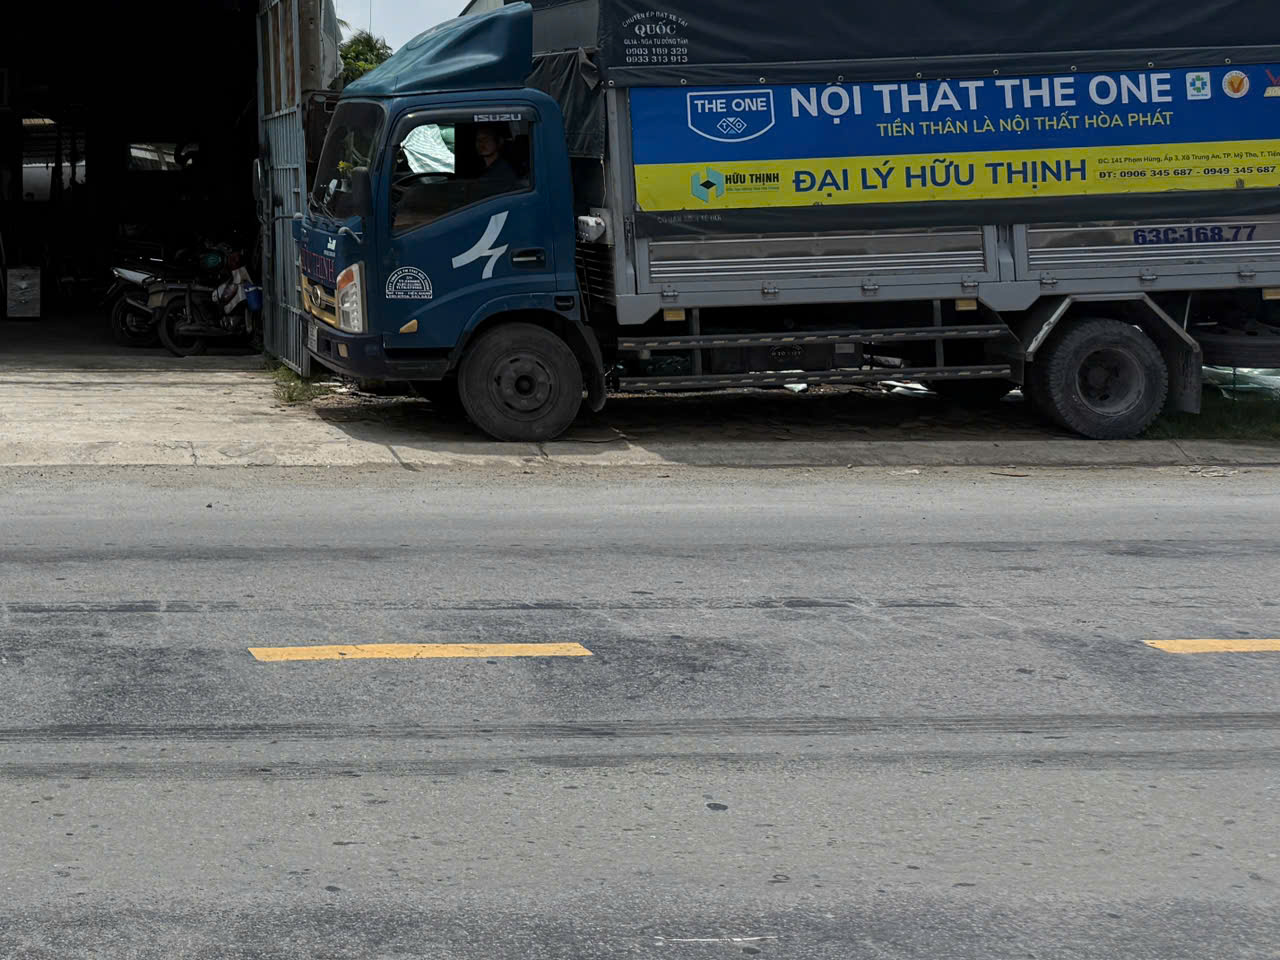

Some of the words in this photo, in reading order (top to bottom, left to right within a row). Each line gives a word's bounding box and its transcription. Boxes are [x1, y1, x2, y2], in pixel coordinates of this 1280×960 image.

[651, 55, 668, 63] 313
[671, 55, 688, 63] 913
[995, 76, 1077, 109] THE
[1088, 73, 1173, 105] ONE
[694, 99, 727, 114] THE
[731, 97, 768, 112] ONE
[474, 113, 522, 122] ISUZU
[919, 118, 968, 135] THÂN
[973, 115, 995, 133] LÀ
[999, 116, 1030, 135] NỘI
[1034, 111, 1080, 131] THẤT
[1084, 110, 1123, 129] HÒA
[1127, 108, 1174, 127] PHÁT
[725, 172, 746, 185] HỮU
[749, 172, 780, 186] THỊNH
[792, 168, 849, 197] ĐẠI
[861, 160, 895, 190] LÝ
[905, 158, 974, 188] HỮU
[984, 159, 1087, 189] THỊNH
[1120, 170, 1146, 178] 0906
[1150, 169, 1170, 177] 345
[1173, 168, 1193, 176] 687
[1203, 167, 1230, 175] 0949
[1233, 166, 1253, 174] 345
[1256, 166, 1276, 174] 687
